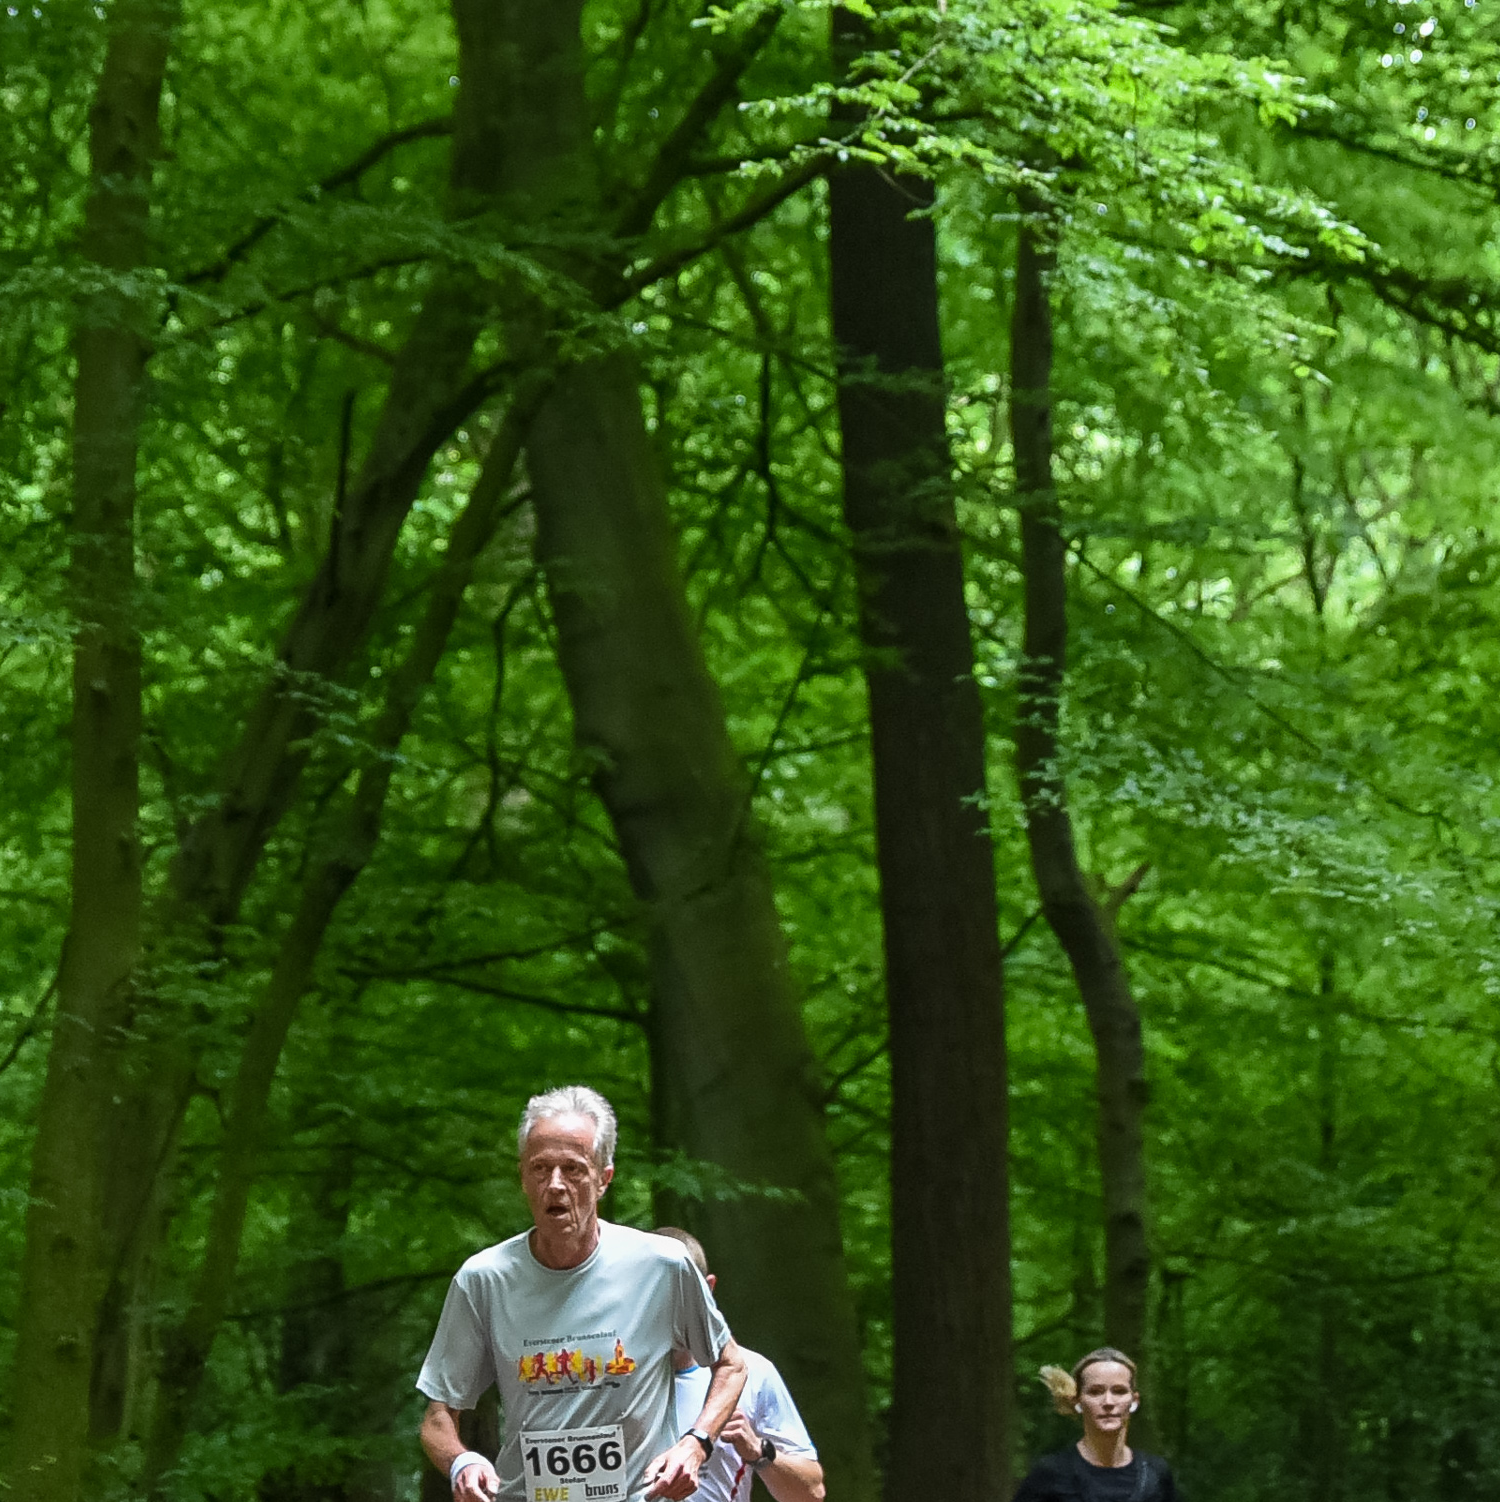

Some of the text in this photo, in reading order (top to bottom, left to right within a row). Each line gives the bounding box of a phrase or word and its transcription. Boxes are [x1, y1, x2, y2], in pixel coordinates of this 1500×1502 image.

[525, 1441, 622, 1476] 1666
[534, 1483, 619, 1502] EWE bruns
